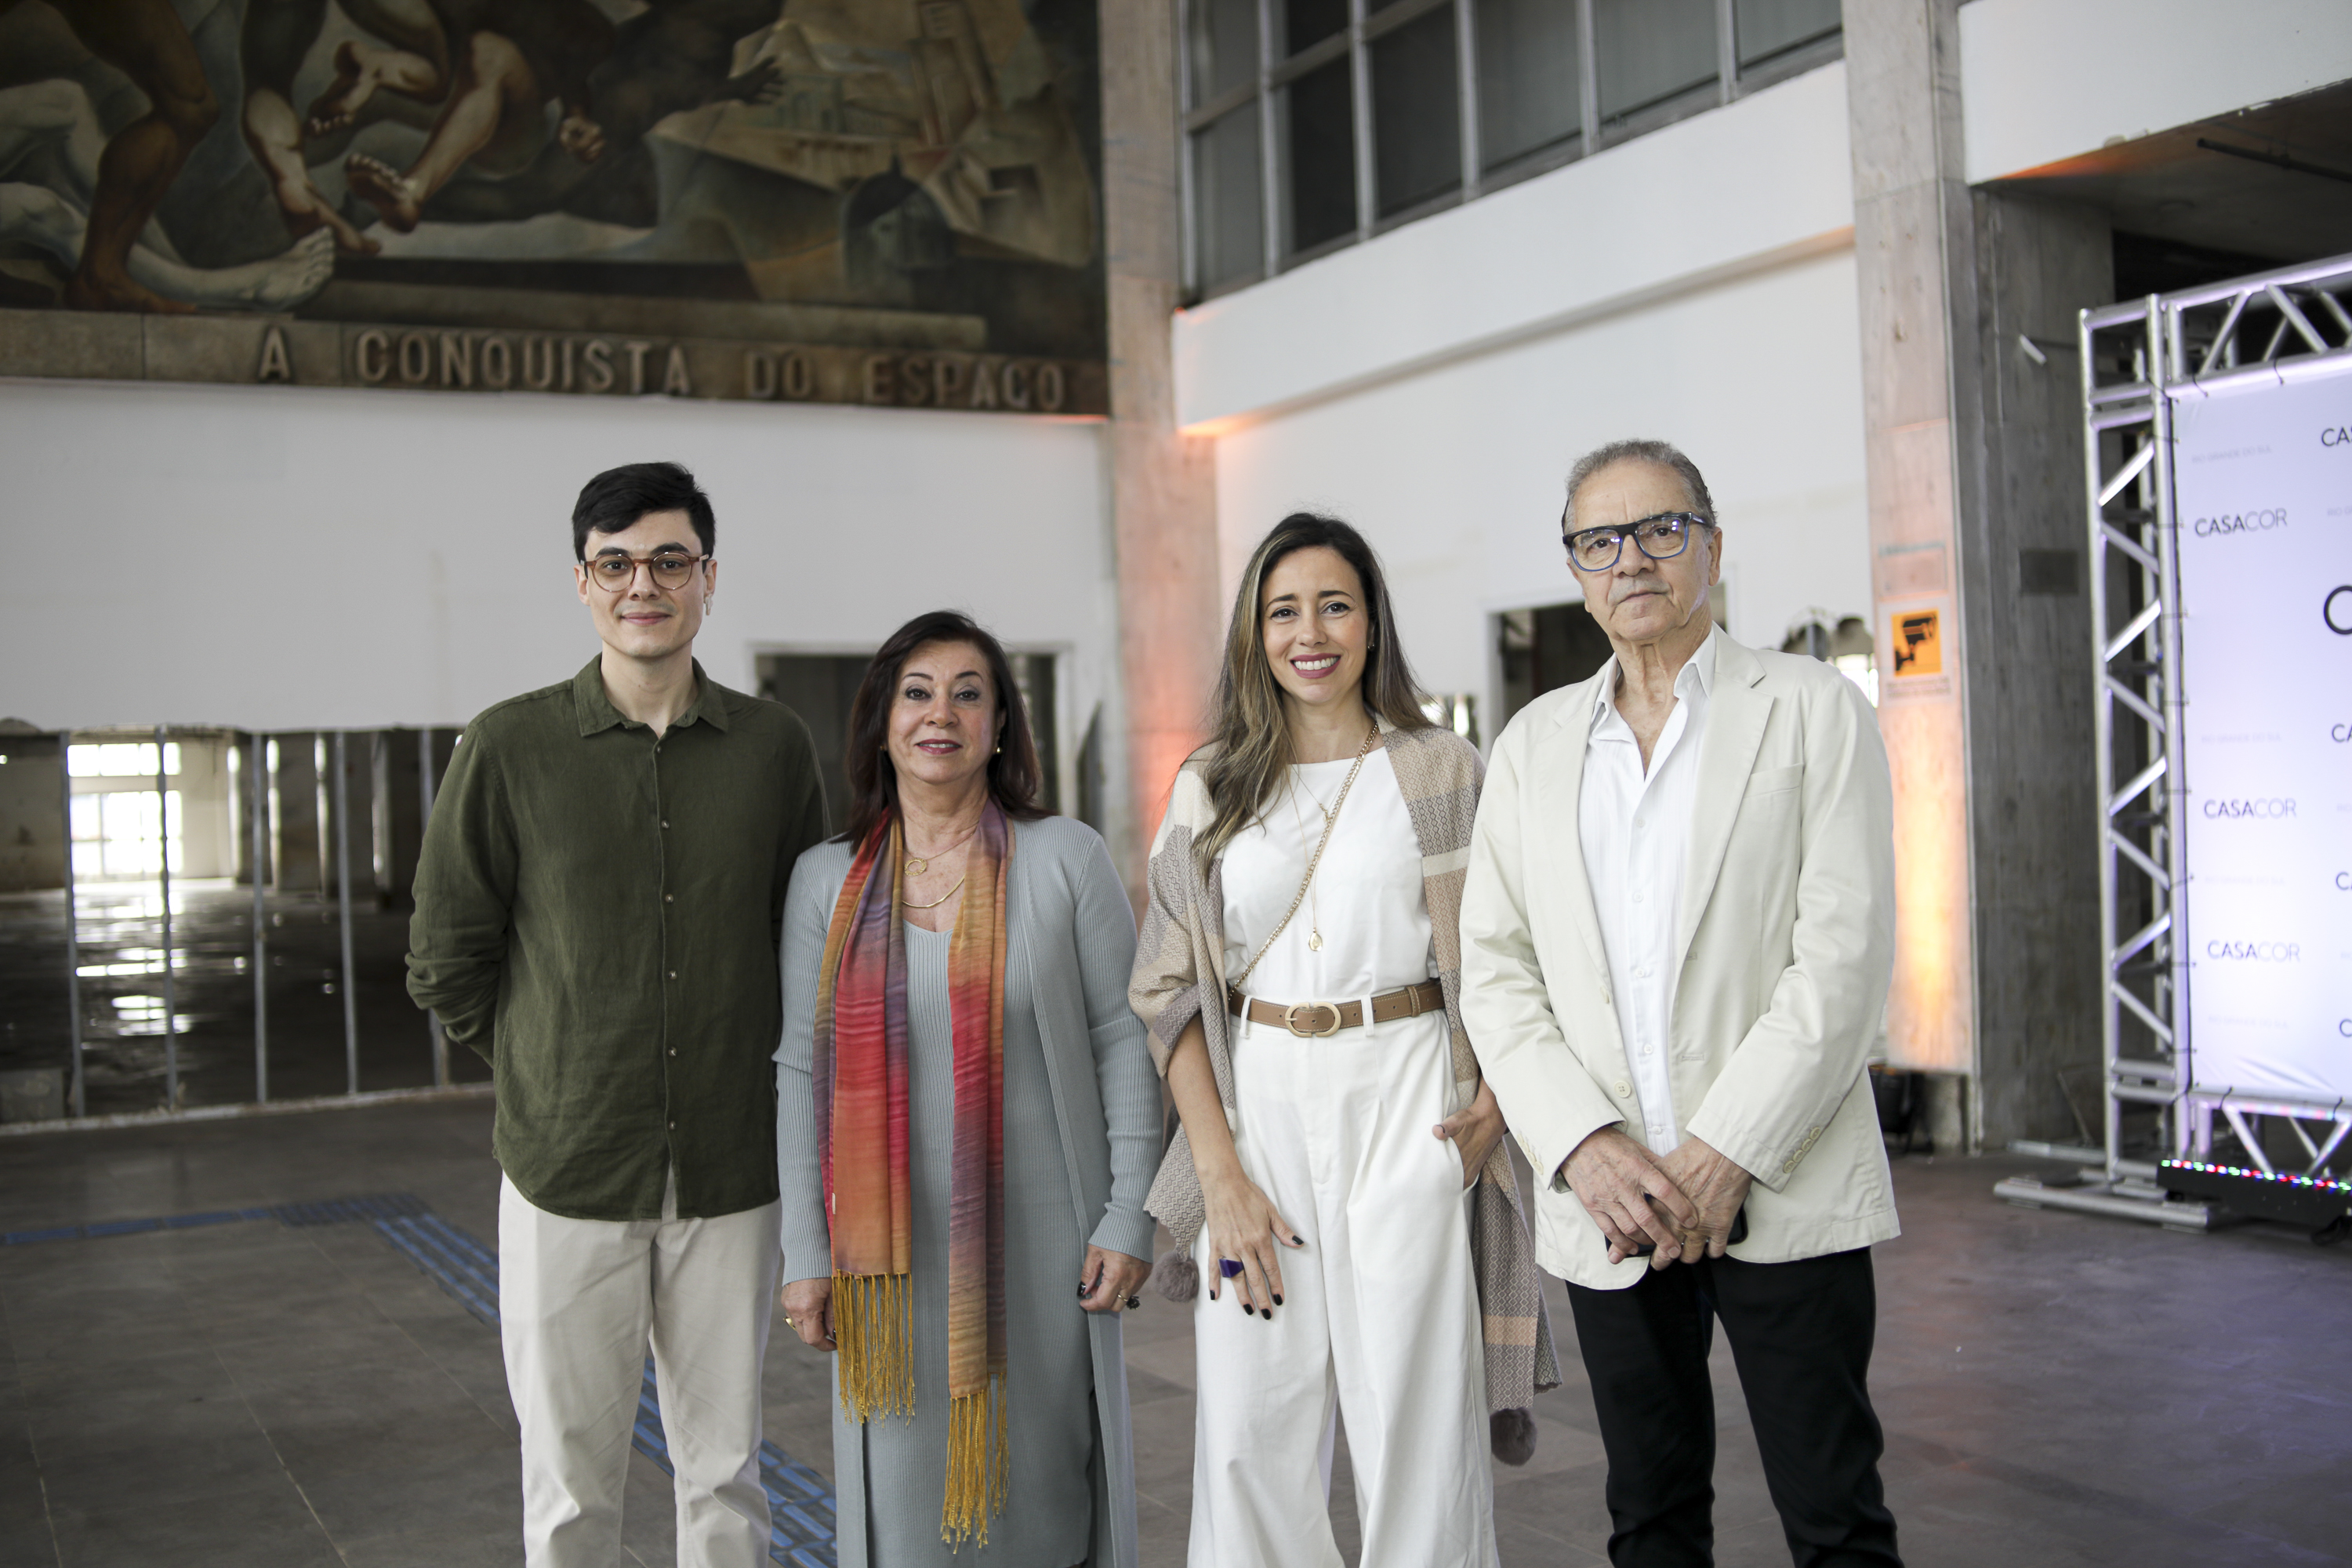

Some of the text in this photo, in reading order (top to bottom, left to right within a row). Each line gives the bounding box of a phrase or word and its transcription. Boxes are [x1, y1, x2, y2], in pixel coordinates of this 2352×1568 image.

[257, 325, 292, 379] A
[356, 329, 690, 394] CONQUISTA
[746, 350, 813, 397] DO
[2321, 426, 2352, 447] CA
[2194, 507, 2287, 538] CASACOR
[2204, 797, 2297, 819] CASACOR
[2208, 940, 2301, 963] CASACOR
